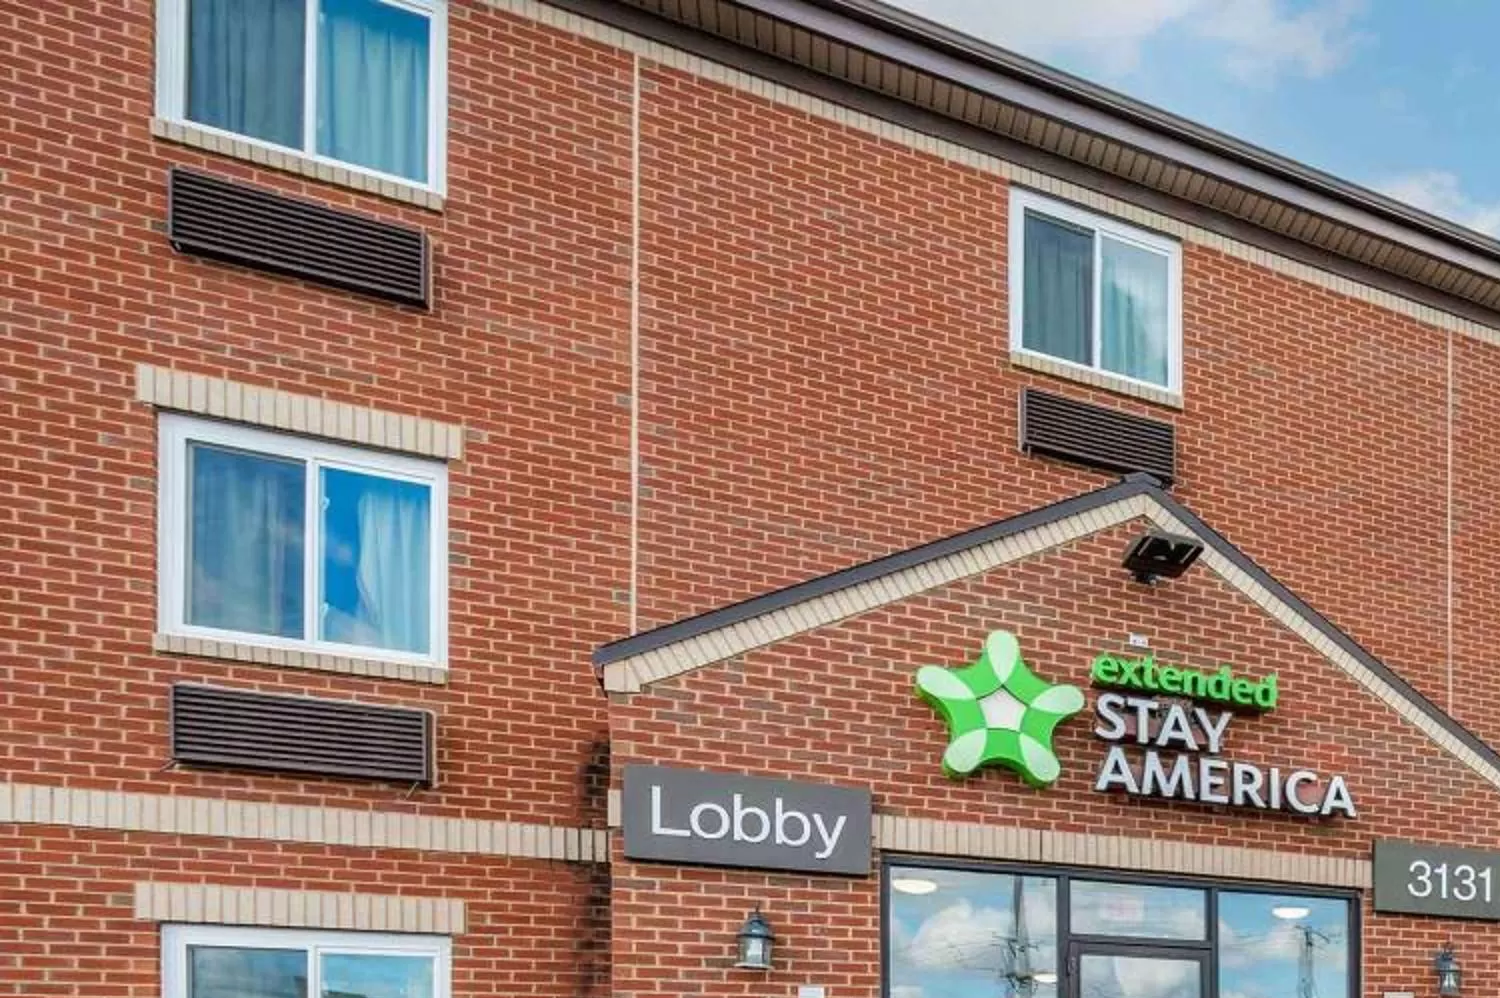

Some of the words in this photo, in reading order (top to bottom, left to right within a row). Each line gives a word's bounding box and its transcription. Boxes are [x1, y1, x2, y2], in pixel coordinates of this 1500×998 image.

[1092, 654, 1278, 708] extended
[1095, 692, 1232, 753] STAY
[1095, 745, 1357, 818] AMERICA
[651, 785, 847, 859] Lobby
[1407, 860, 1492, 902] 3131
